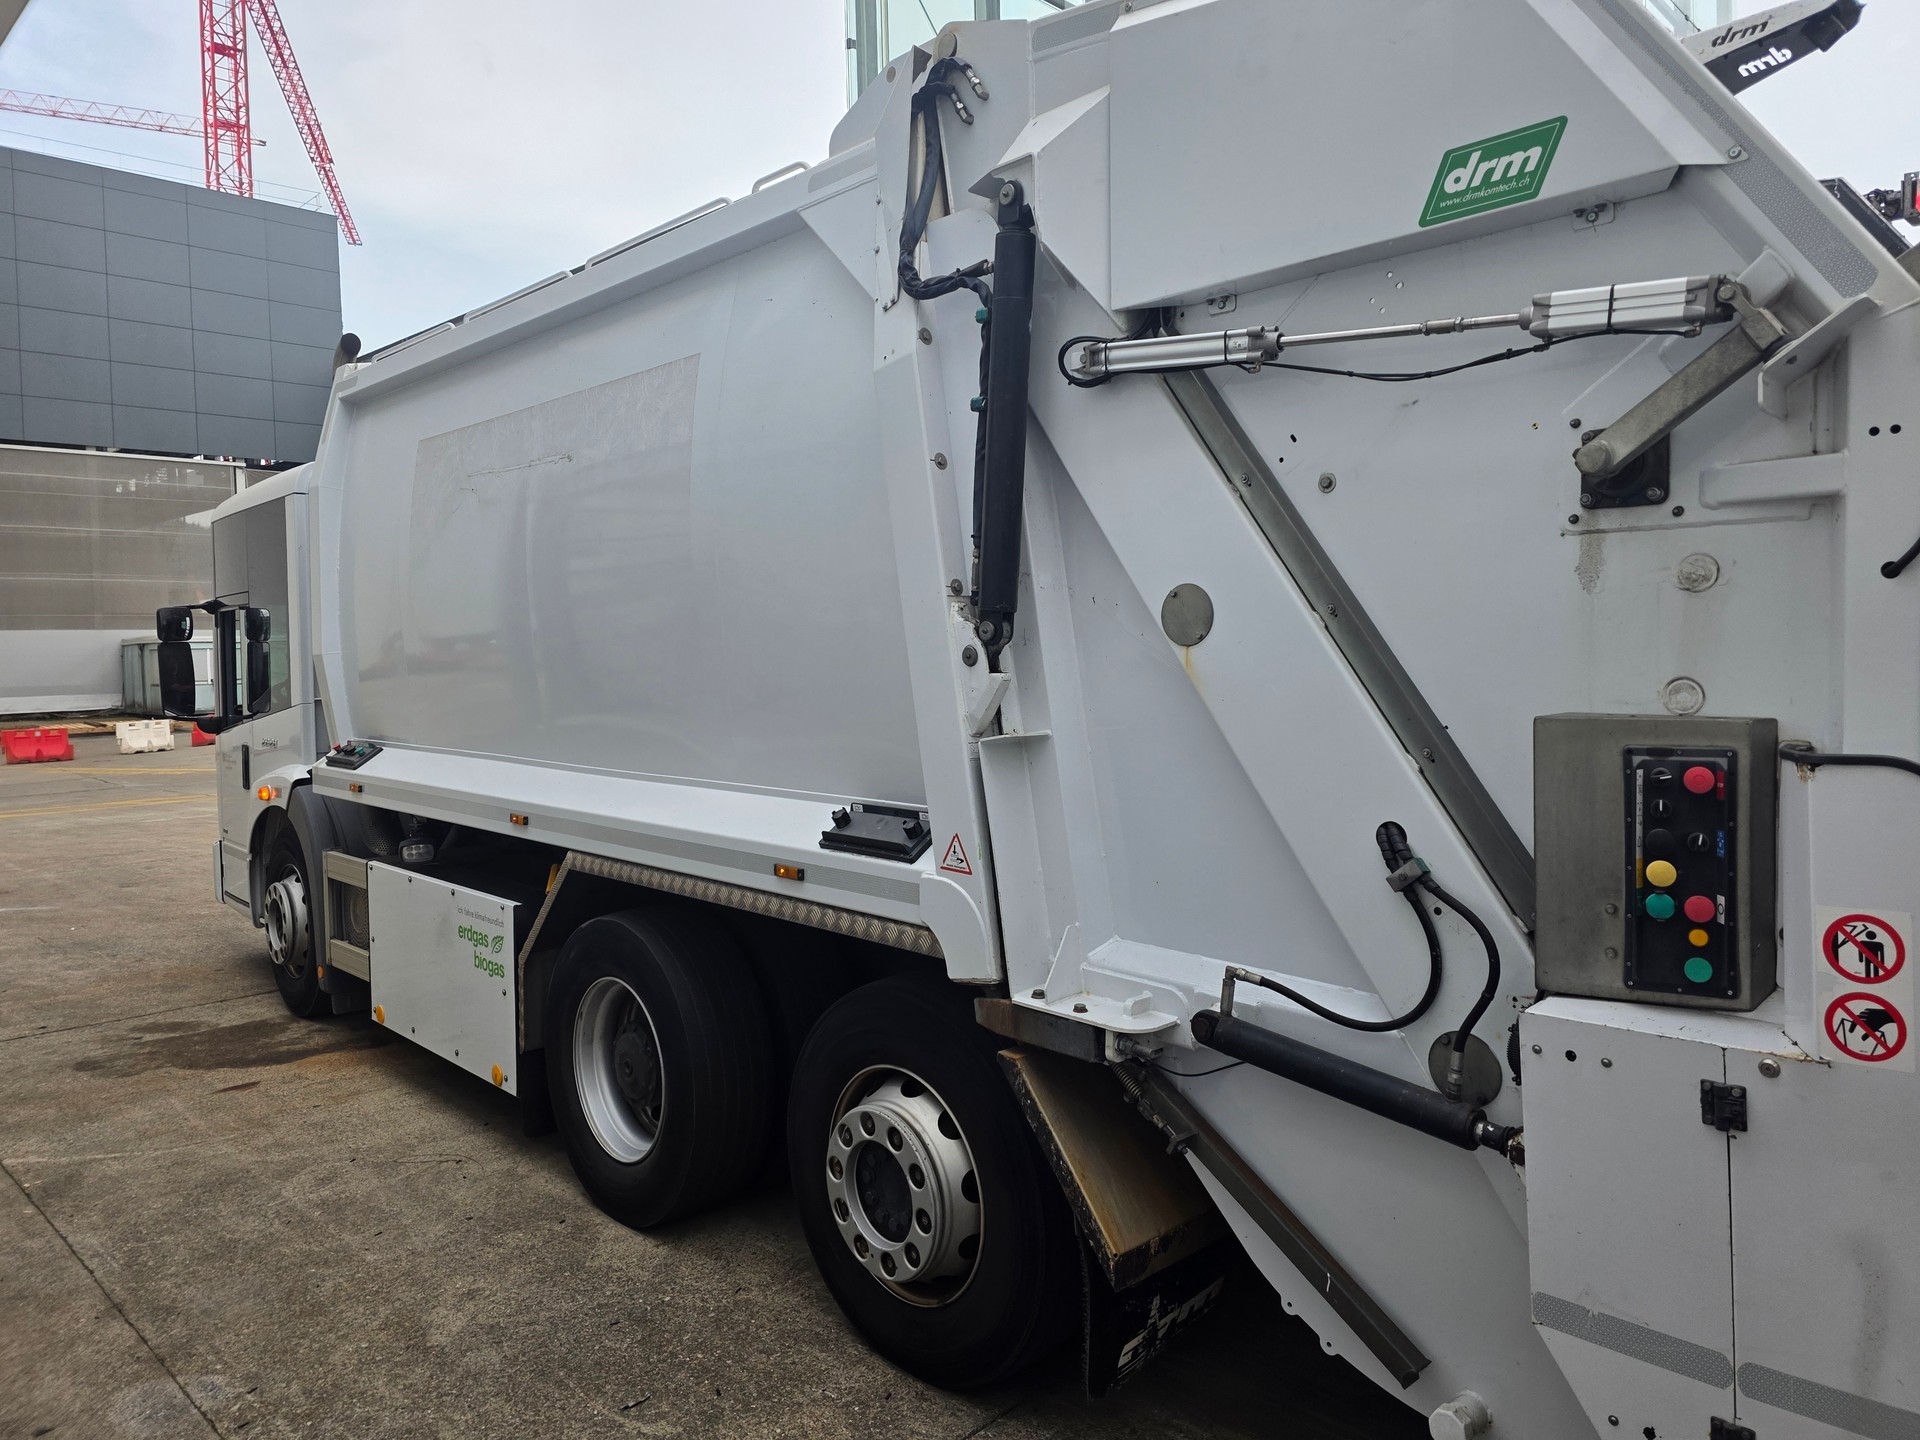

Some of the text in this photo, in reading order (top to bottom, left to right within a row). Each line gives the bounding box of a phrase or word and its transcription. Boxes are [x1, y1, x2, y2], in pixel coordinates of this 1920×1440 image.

[1711, 20, 1768, 48] drm
[1443, 145, 1543, 194] drm
[1439, 174, 1531, 208] www.drmkomtech.ch
[458, 924, 489, 948] erdgas
[473, 950, 505, 978] biogas
